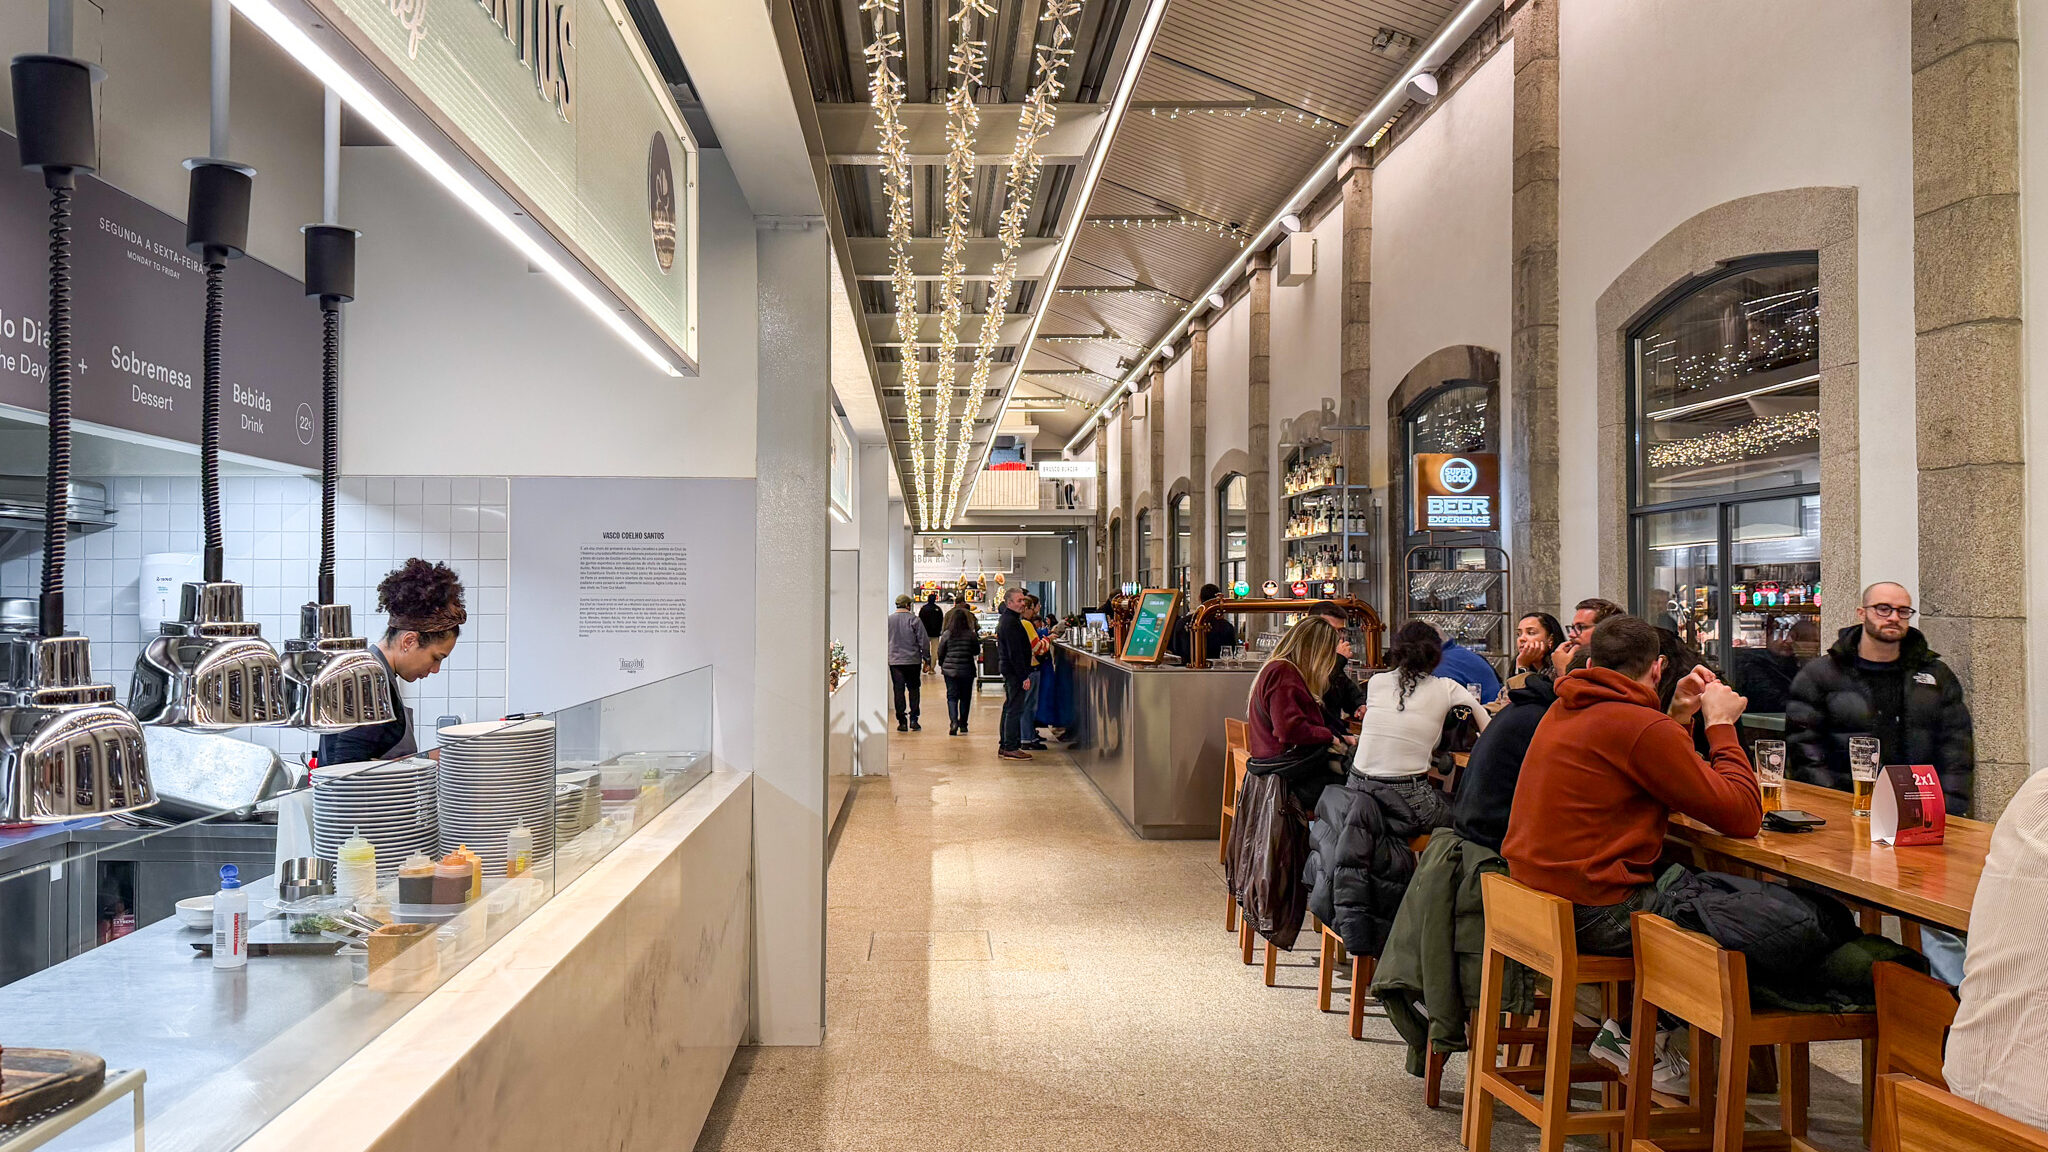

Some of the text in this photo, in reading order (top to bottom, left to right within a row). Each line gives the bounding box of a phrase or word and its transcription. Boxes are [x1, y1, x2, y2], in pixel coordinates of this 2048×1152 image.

[99, 217, 204, 275] SEGUNDA A SEXTA-FEIRA
[127, 250, 180, 280] MONDAY TO FRIDAY
[0, 309, 51, 349] o Dia
[0, 347, 48, 384] he Day
[111, 345, 192, 390] Sobremesa
[132, 384, 173, 412] Dessert
[233, 383, 272, 412] Bebida
[241, 414, 264, 434] Drink
[1444, 467, 1472, 476] SUPER
[1446, 475, 1471, 483] BOCK
[1427, 498, 1490, 515] BEER
[1427, 515, 1491, 524] EXPERIENCE
[602, 531, 665, 540] VASCO COELHO SANTOS
[1912, 772, 1936, 786] 2x1
